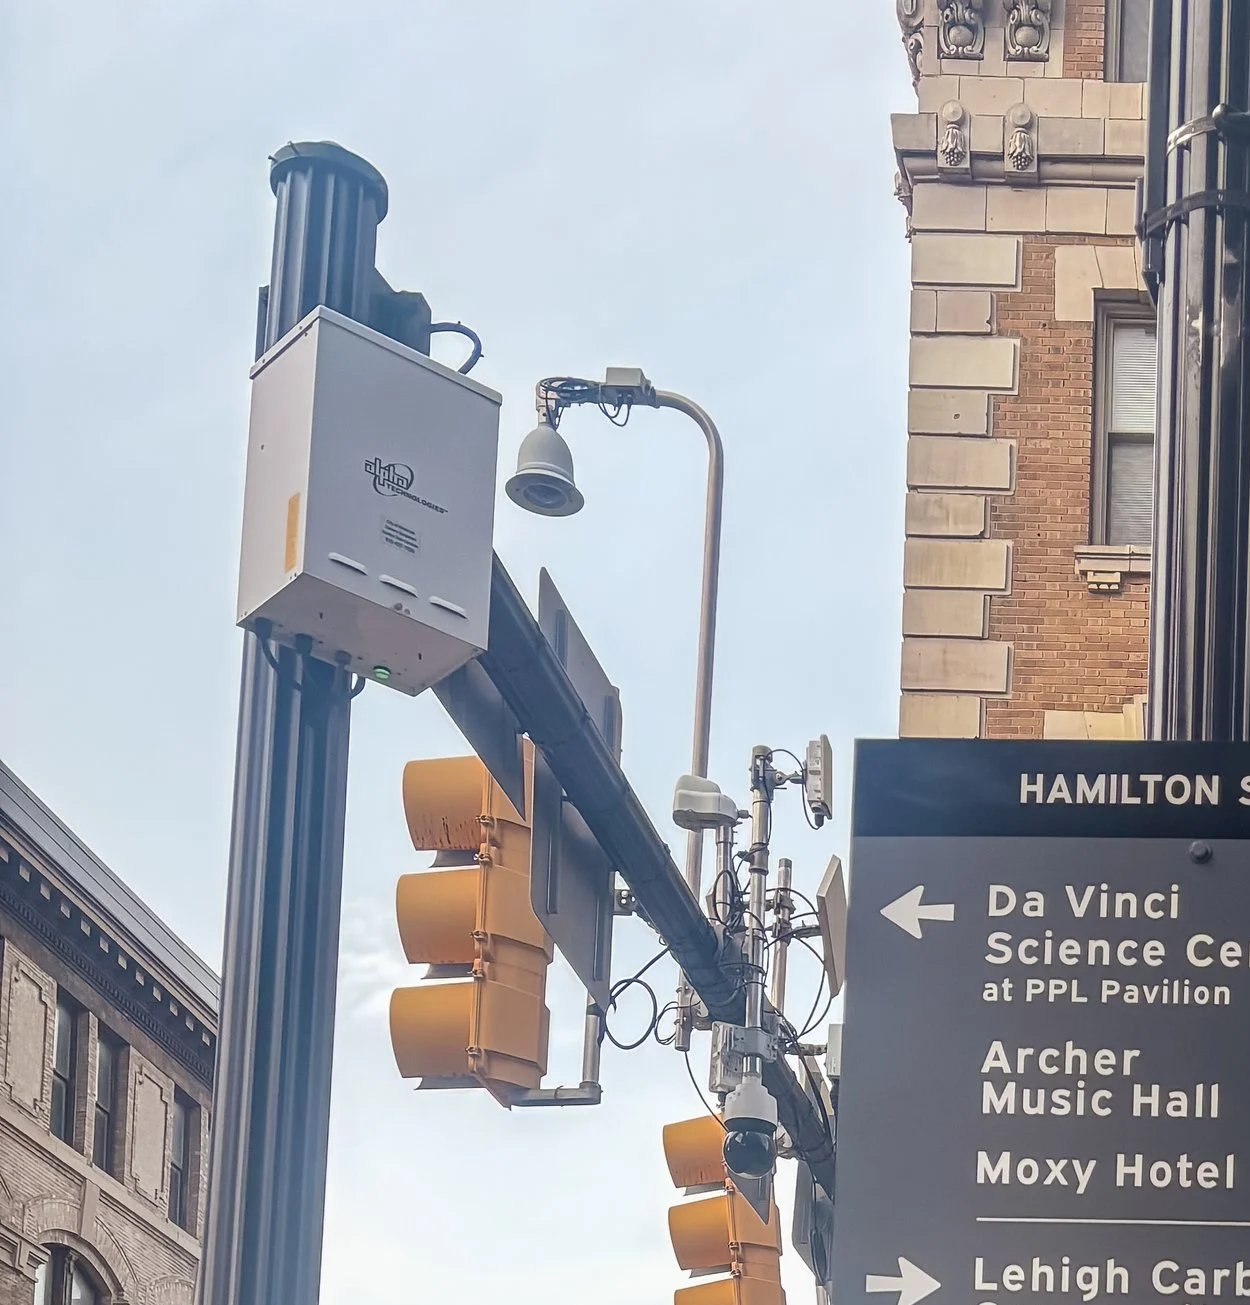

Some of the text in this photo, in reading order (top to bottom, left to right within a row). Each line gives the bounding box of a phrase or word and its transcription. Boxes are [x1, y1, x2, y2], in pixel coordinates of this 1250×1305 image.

[1020, 774, 1220, 805] HAMILTON
[989, 883, 1179, 919] Da Vinci
[985, 930, 1166, 967] Science
[983, 978, 1231, 1005] at PPL Pavilion
[981, 1041, 1141, 1076] Archer
[983, 1081, 1220, 1118] Music Hall
[977, 1151, 1235, 1195] Moxy Hotel
[975, 1257, 1130, 1303] Lehigh
